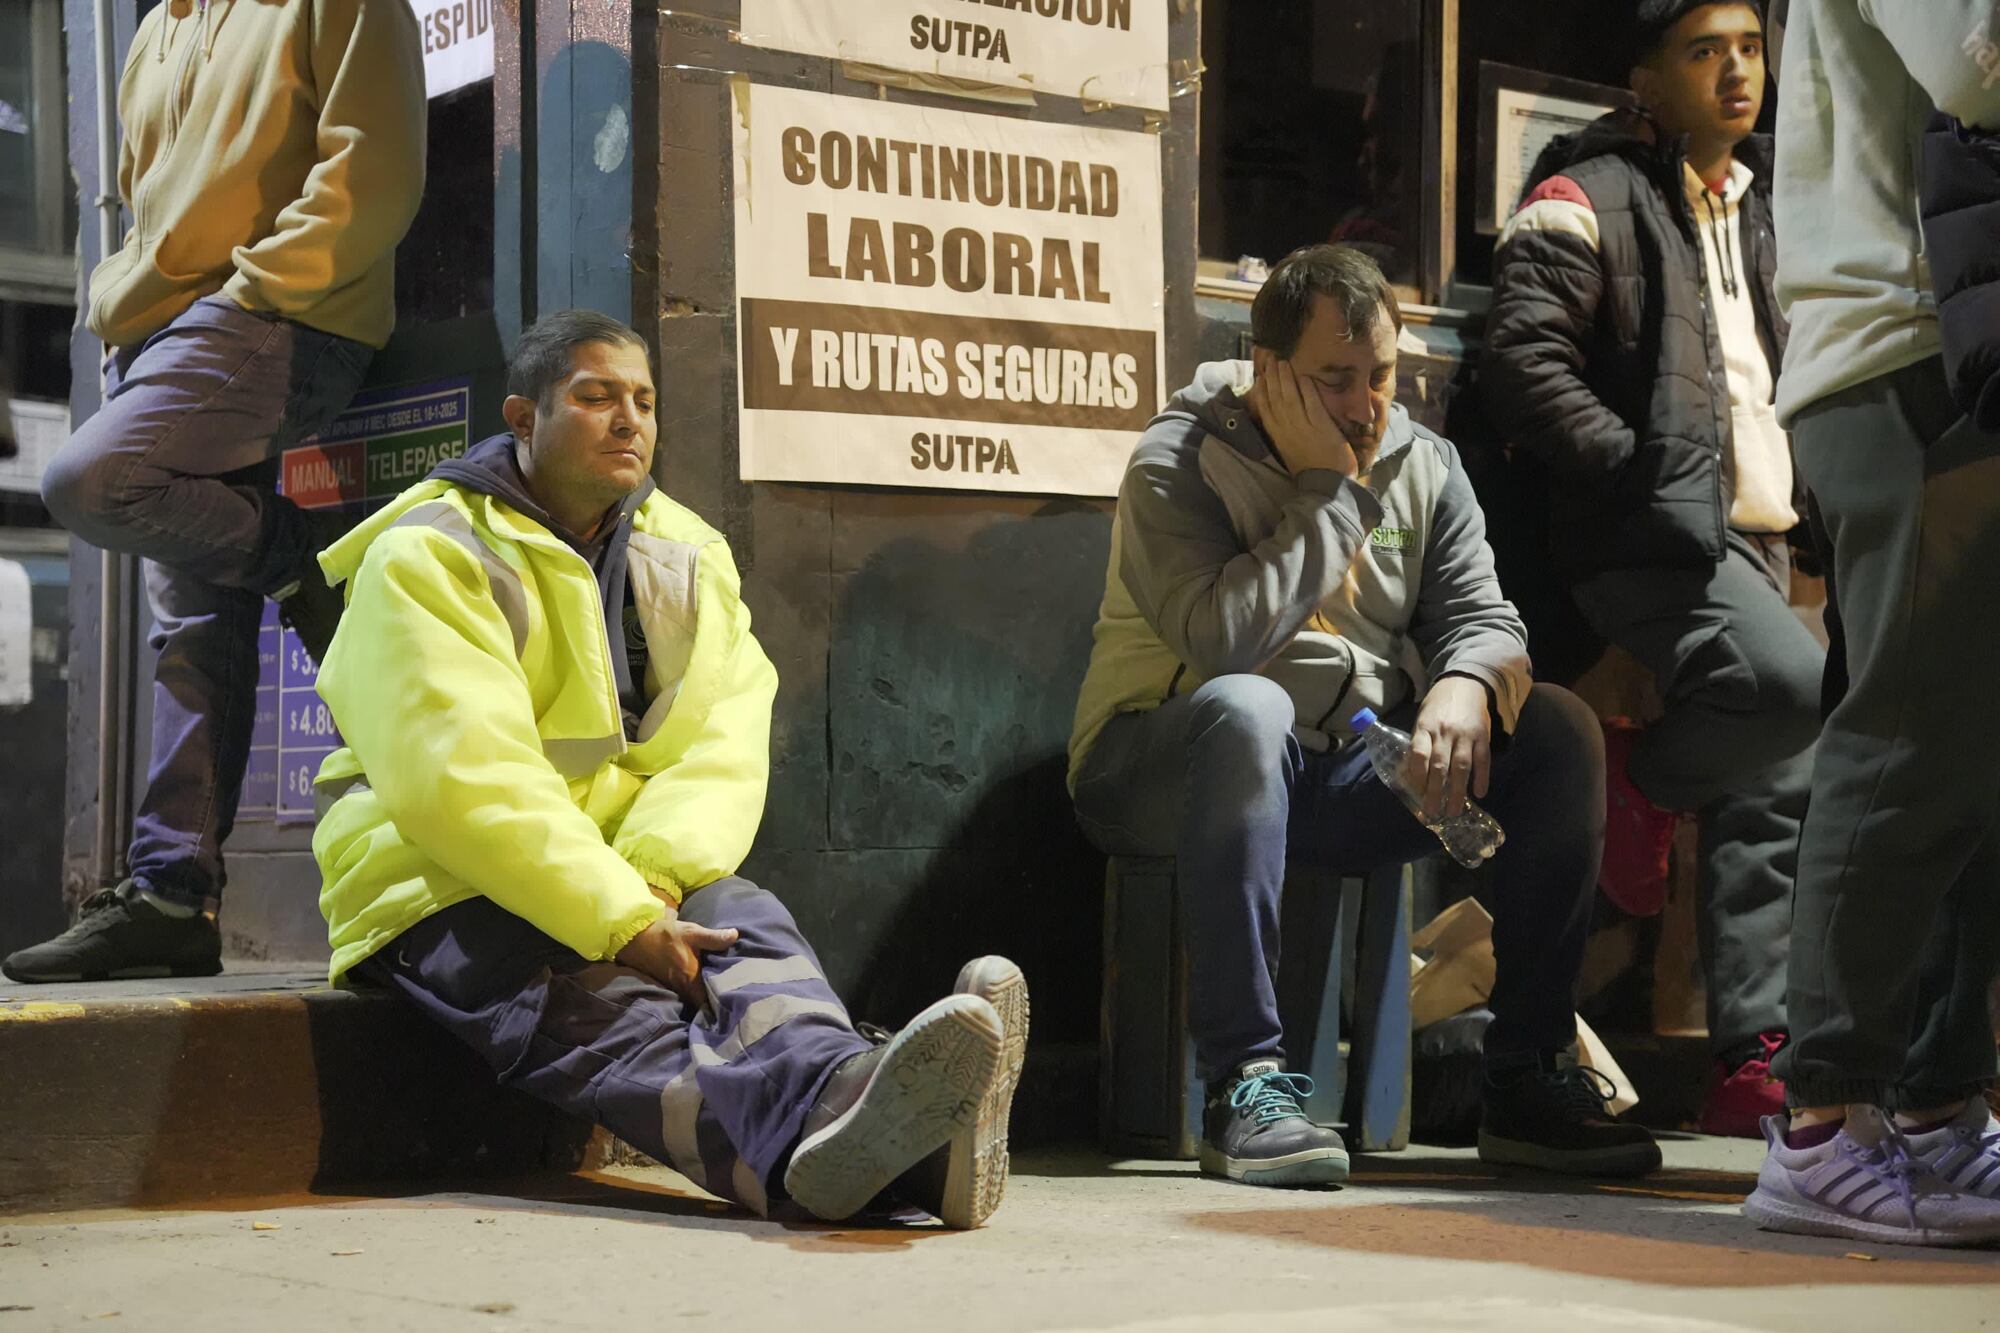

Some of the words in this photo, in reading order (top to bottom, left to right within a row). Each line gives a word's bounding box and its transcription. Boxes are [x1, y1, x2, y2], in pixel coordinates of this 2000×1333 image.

[418, 0, 493, 55] ESPID
[910, 15, 1011, 64] SUTPA
[781, 126, 1119, 218] CONTINUIDAD
[807, 212, 1111, 304] LABORAL
[769, 327, 799, 386] Y
[811, 329, 949, 396] RUTAS
[955, 341, 1139, 410] SEGURAS
[291, 456, 356, 495] MANUAL
[368, 440, 463, 482] TELEPASE
[910, 432, 1020, 475] SUTPA
